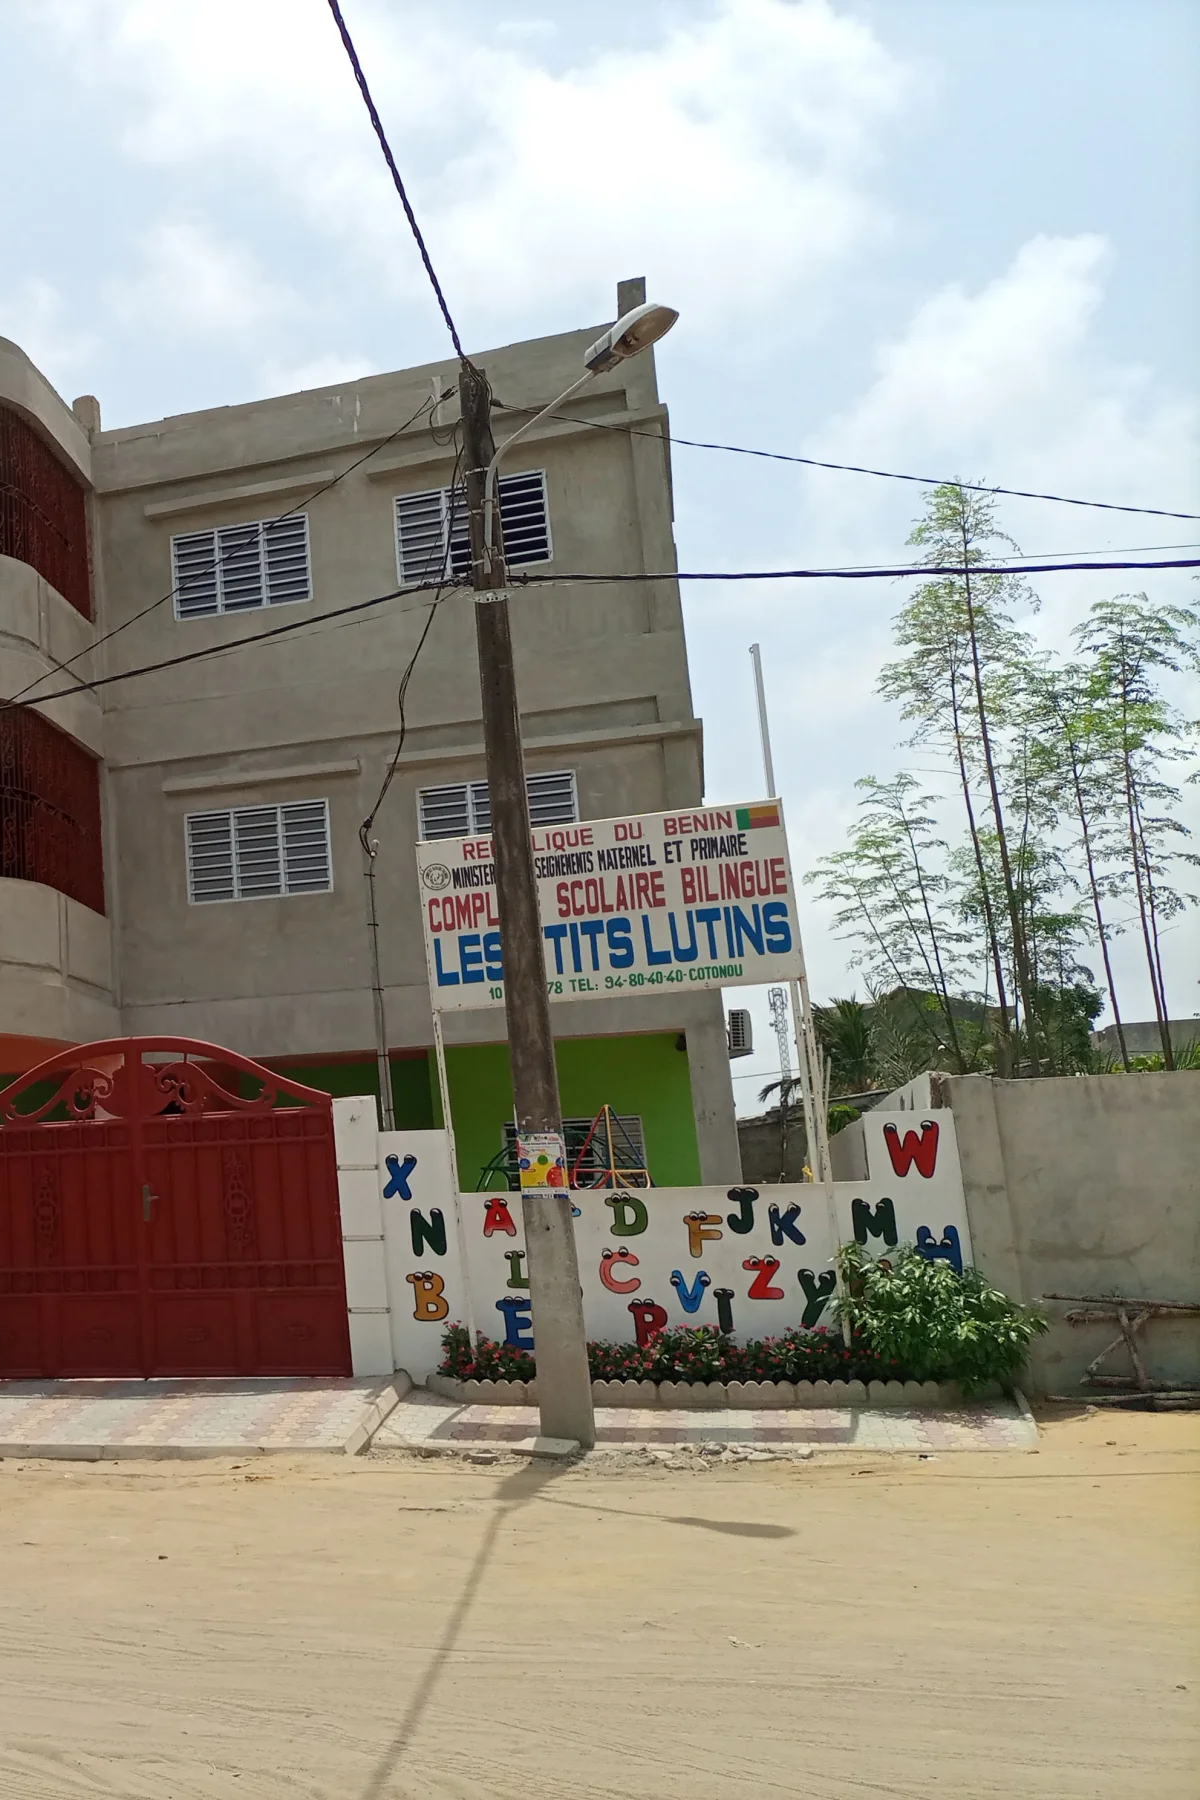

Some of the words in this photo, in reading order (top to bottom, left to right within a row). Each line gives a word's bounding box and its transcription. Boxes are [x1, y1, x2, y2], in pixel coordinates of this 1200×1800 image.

[462, 828, 594, 860] RELIQUE
[614, 822, 643, 841] DU
[663, 811, 732, 836] BENIN
[452, 863, 497, 889] MINISTER
[534, 850, 594, 879] SEIGNEMENTS
[597, 844, 657, 871] MATERNEL
[663, 840, 683, 864] ET
[690, 833, 748, 861] PRIMAIRE
[428, 891, 500, 932] COMPL
[556, 871, 666, 917] SCOLAIRE
[680, 857, 788, 904] BILINGUE
[433, 932, 504, 987] LES
[543, 917, 634, 975] TITS
[642, 902, 792, 967] LUTINS
[569, 978, 599, 992] TEL:
[883, 1120, 939, 1178] W
[383, 1154, 417, 1201] X
[410, 1208, 447, 1257] N
[483, 1198, 517, 1237] A
[604, 1192, 648, 1236] D
[683, 1211, 723, 1258] F
[727, 1187, 759, 1234] J
[768, 1202, 806, 1246] K
[852, 1198, 898, 1246] M
[599, 1246, 641, 1294] C
[670, 1269, 711, 1313] V
[742, 1254, 784, 1300] Z
[406, 1271, 449, 1322] B
[797, 1268, 837, 1330] Y
[495, 1296, 535, 1350] E
